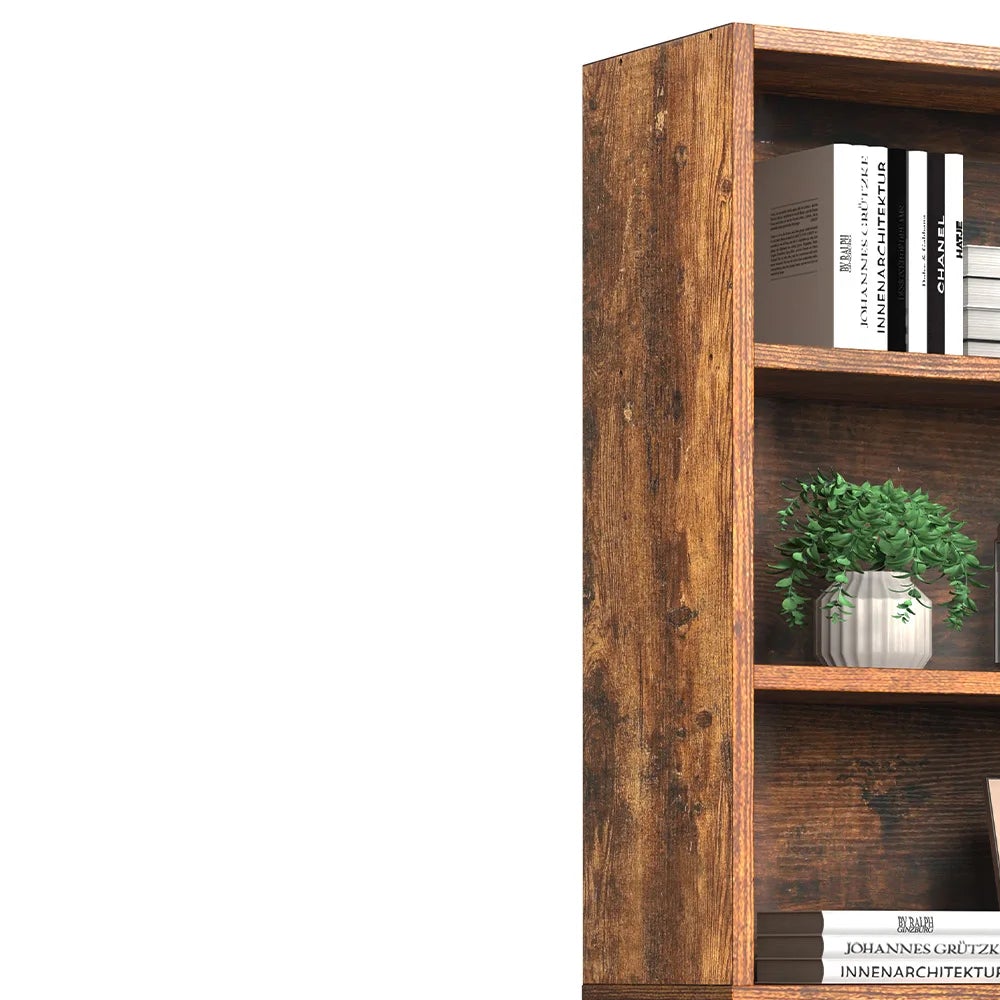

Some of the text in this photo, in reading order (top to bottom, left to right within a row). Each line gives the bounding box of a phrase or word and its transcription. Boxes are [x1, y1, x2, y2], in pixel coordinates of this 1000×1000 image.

[858, 155, 868, 328] JOHANNES GRÜTZKE
[877, 161, 886, 334] INNENARCHITEKTUR
[937, 215, 945, 294] CHANEL
[844, 942, 931, 955] JOHANNES
[898, 916, 934, 928] BY RALPH
